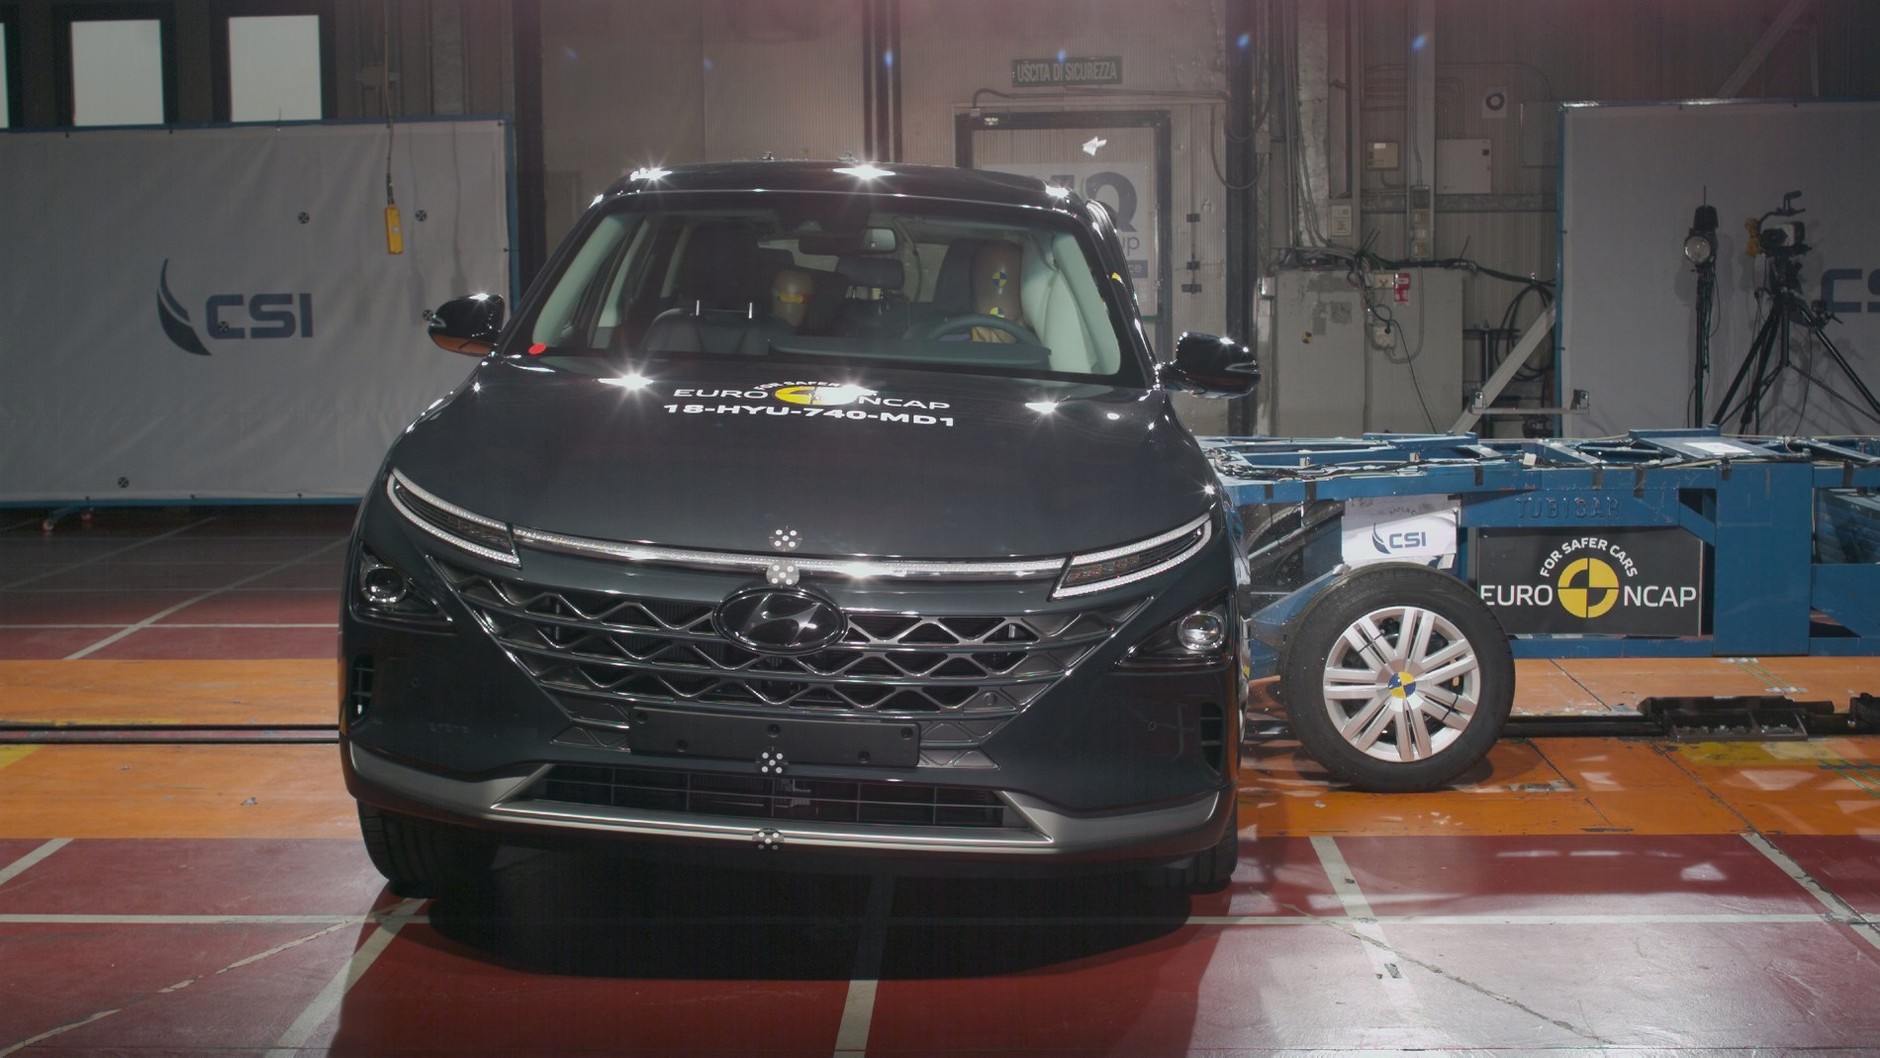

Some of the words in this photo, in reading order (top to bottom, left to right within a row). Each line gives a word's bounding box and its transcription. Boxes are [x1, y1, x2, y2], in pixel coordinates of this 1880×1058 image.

[1017, 63, 1051, 82] USCITA
[1053, 62, 1063, 81] DI
[1065, 61, 1118, 81] SICUREZZA
[205, 292, 313, 340] CSI
[673, 388, 769, 399] EURO
[858, 396, 951, 410] NCAP
[663, 403, 955, 427] 18-HYU-740-MD1
[1388, 531, 1427, 549] CSI
[1539, 550, 1563, 578] FOR
[1562, 537, 1609, 555] SAFER
[1609, 545, 1638, 578] CARS
[1479, 584, 1553, 607] EURO
[1623, 585, 1697, 608] NCAP
